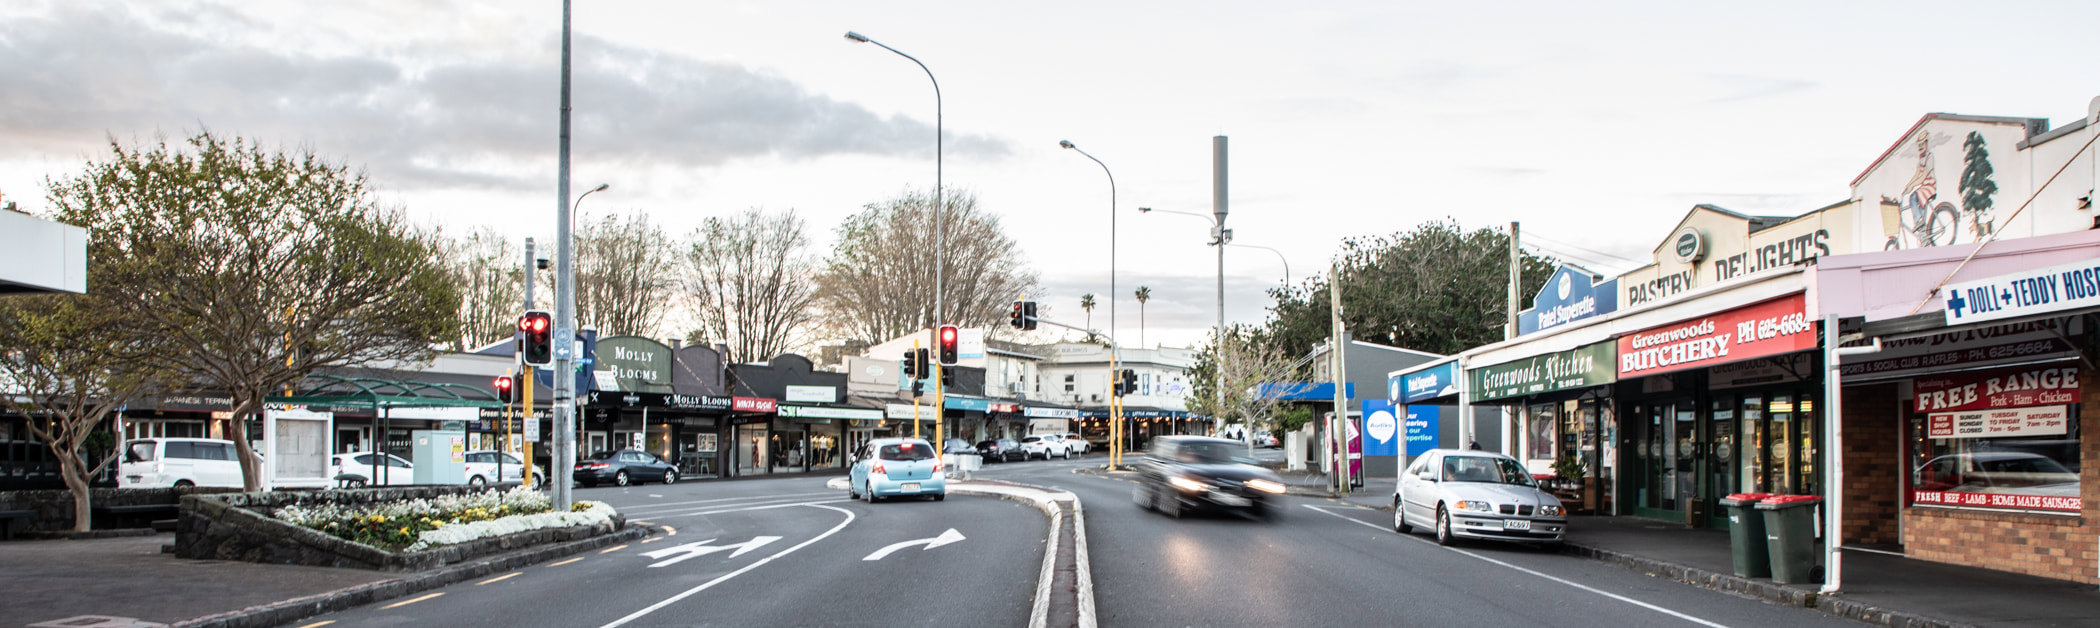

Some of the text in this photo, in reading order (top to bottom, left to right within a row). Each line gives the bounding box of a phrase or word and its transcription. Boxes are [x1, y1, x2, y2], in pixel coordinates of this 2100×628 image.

[1629, 269, 1693, 307] PASTRY
[1714, 229, 1829, 282] DELIGHTS
[1538, 296, 1595, 330] Patel Superette
[1632, 319, 1715, 350] Greenwoods
[1737, 320, 1755, 345] PH
[1757, 312, 1811, 341] 625-6684
[615, 346, 653, 362] MOLLY
[1621, 333, 1731, 373] BUTCHERY
[1841, 364, 1865, 375] SPORTS
[1873, 361, 1898, 370] SOCIAL
[1901, 359, 1919, 369] CLUB
[1922, 353, 1958, 365] RAFFLES
[1989, 340, 2052, 359] 625-6684
[611, 365, 657, 381] BLOOMS
[1408, 373, 1437, 392] Patel Superette
[1484, 349, 1593, 396] Greenwoods Kitchen
[672, 394, 730, 406] MOLLY BLOOMS
[1918, 368, 2079, 411] FREE RANGE
[1990, 396, 2008, 408] Pork
[2014, 394, 2033, 406] Ham
[2039, 391, 2072, 404] Chicken
[736, 400, 754, 409] NINJA
[756, 401, 772, 410] SUSHI
[1406, 420, 1428, 428] earing
[1915, 491, 1941, 502] FRESH
[1944, 493, 1961, 503] BEEF
[1965, 493, 1987, 505] LAMB
[1992, 495, 2015, 506] HOME
[2016, 496, 2040, 507] MADE
[2042, 497, 2081, 509] SAUSAGES
